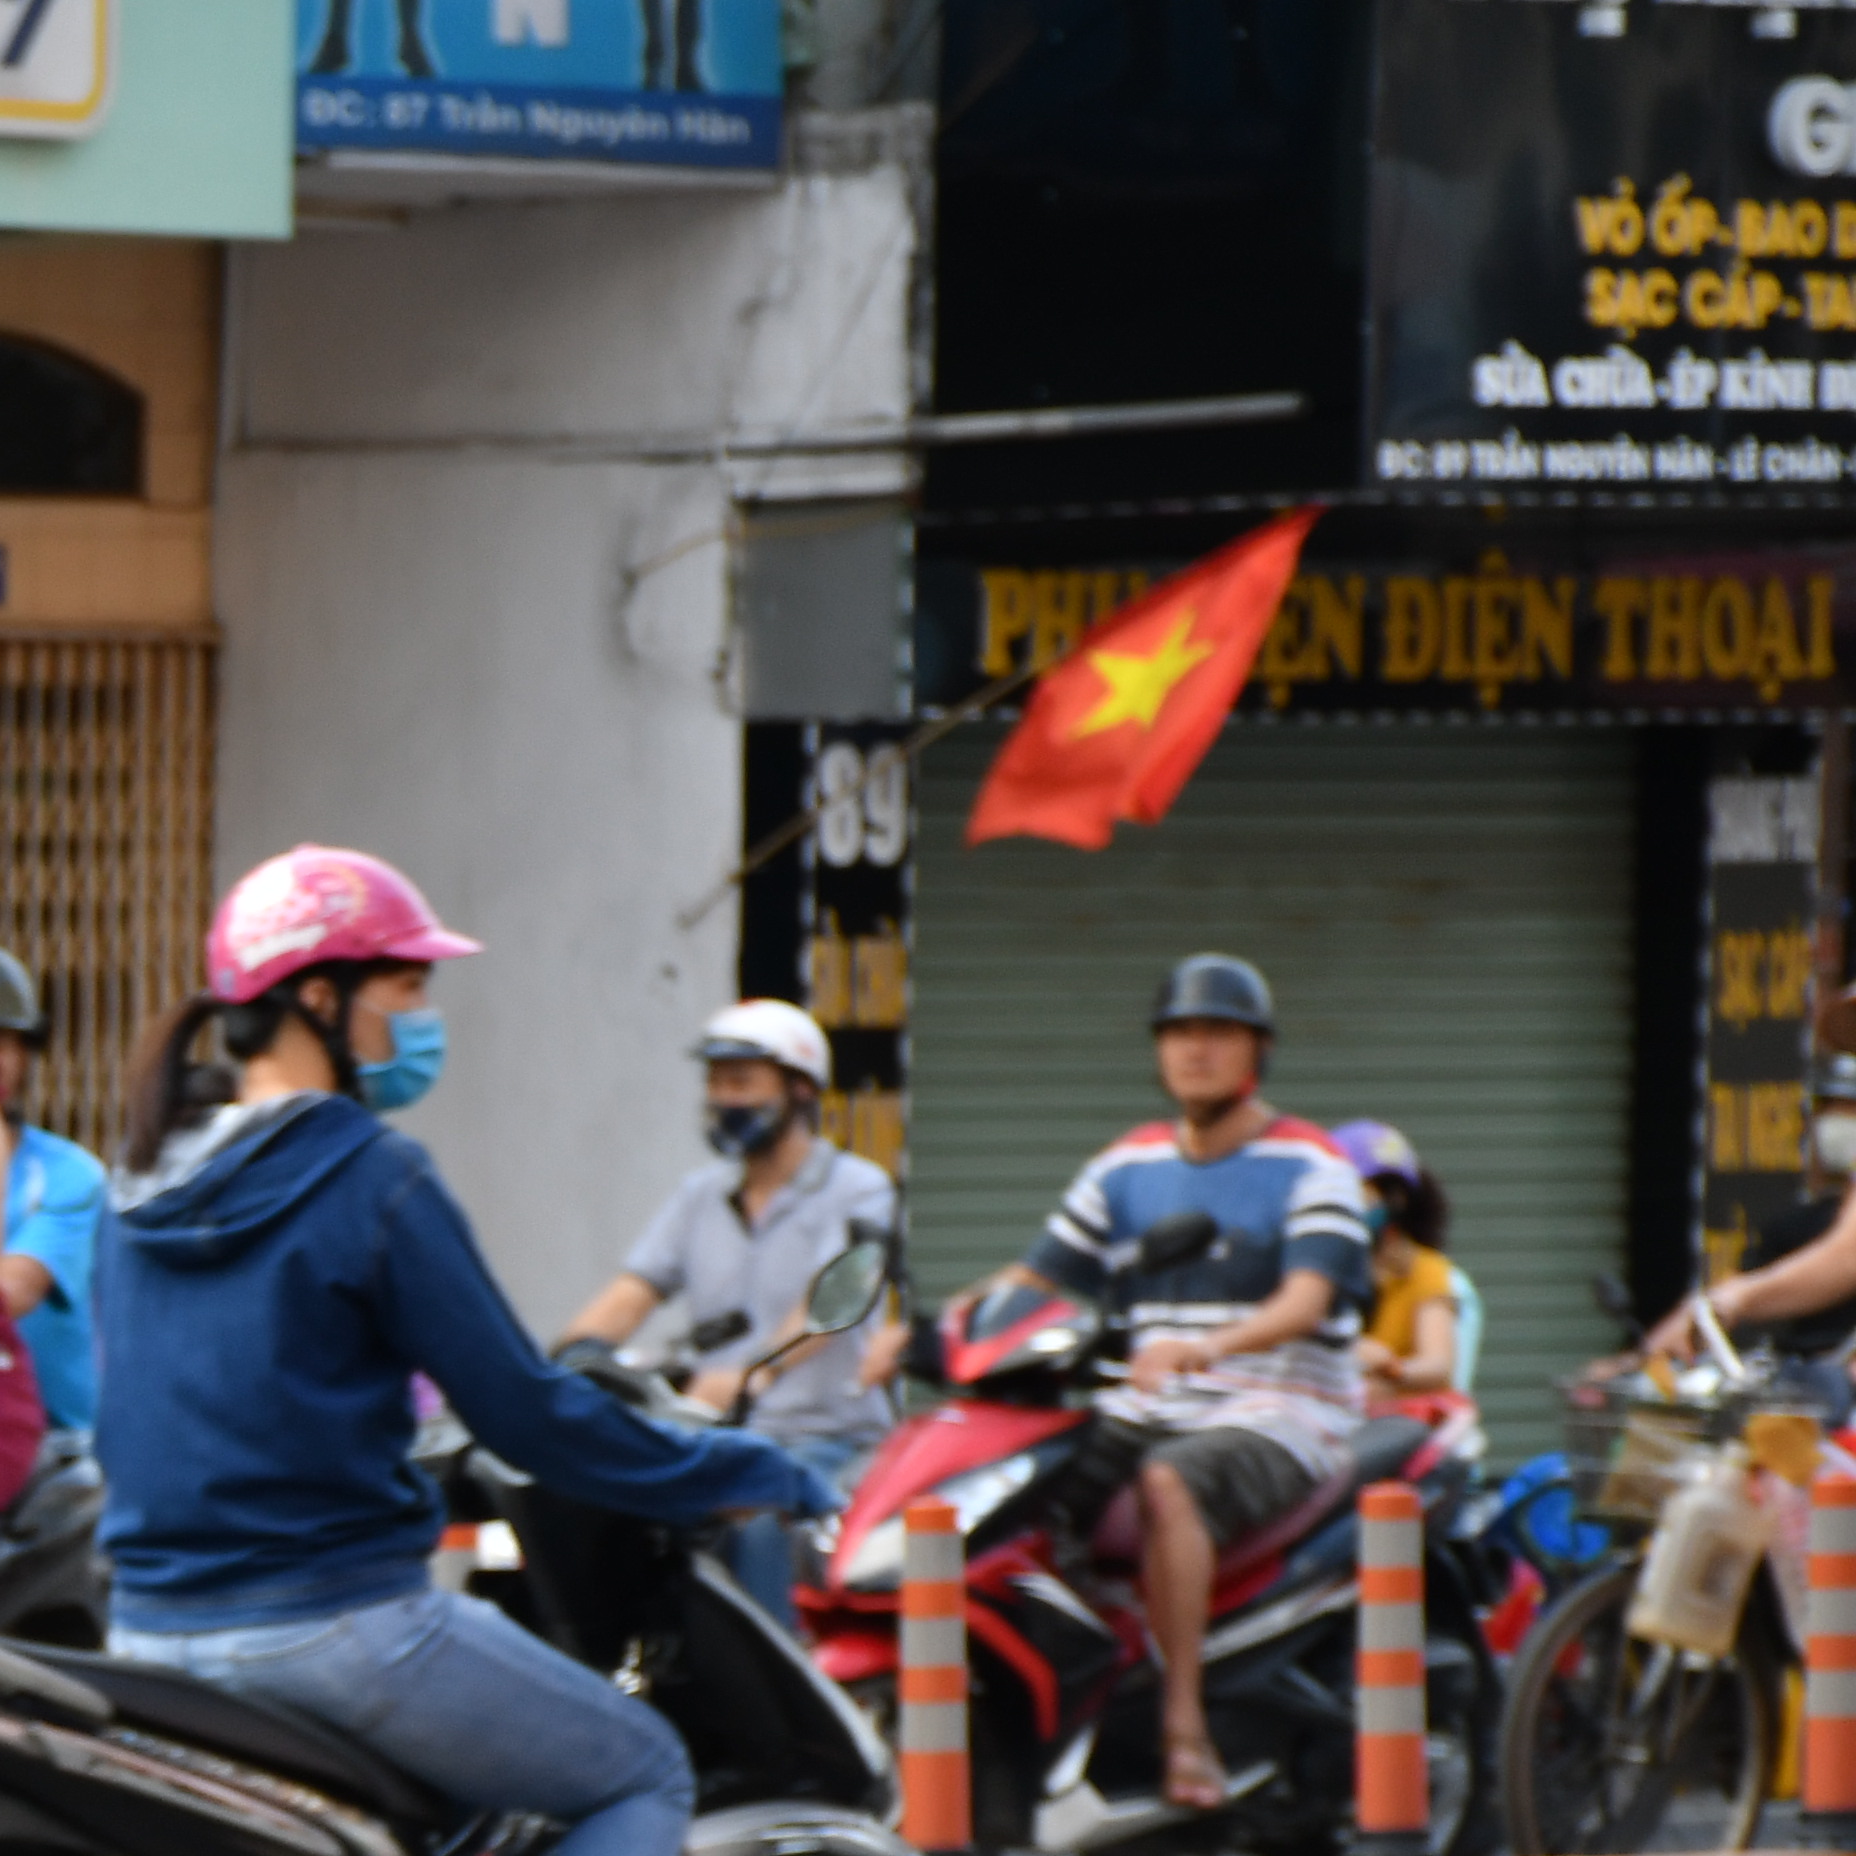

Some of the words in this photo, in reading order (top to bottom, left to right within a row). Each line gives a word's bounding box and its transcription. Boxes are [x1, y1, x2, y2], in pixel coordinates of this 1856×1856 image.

[439, 91, 523, 136] Trần
[526, 98, 672, 146] Nguyên
[1575, 175, 1646, 258] VỎ
[1585, 264, 1680, 342] SẠC
[1382, 546, 1578, 708] ĐIỆN
[1592, 572, 1838, 704] THOẠI
[818, 742, 909, 868] 89
